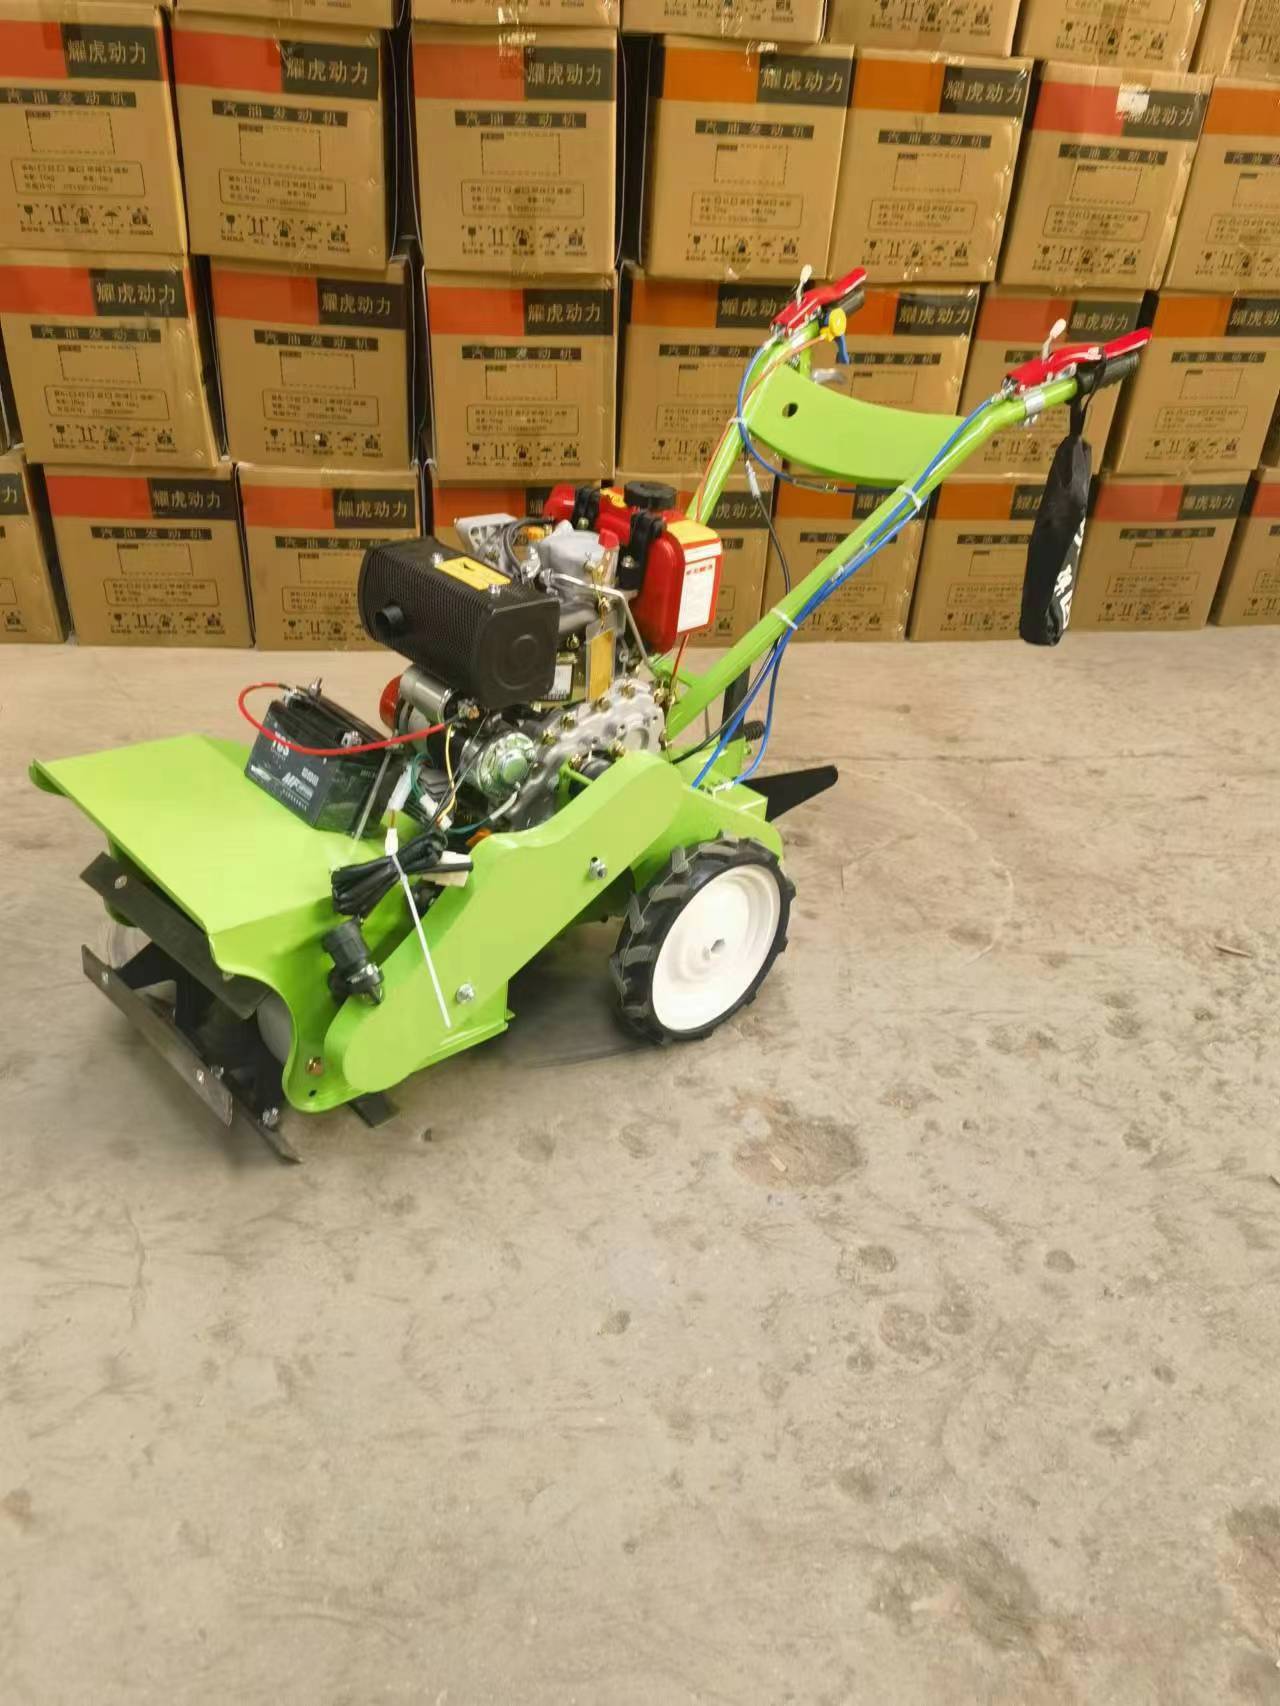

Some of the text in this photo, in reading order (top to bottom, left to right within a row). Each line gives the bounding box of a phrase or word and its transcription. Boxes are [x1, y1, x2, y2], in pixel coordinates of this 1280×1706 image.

[69, 40, 146, 64] 耀虎动力
[287, 58, 368, 84] 耀虎动力
[528, 63, 602, 87] 耀虎动力
[761, 66, 843, 93] 耀虎动力
[945, 81, 1022, 105] 耀虎动力
[97, 283, 175, 305] 耀虎动力
[321, 292, 391, 315] 耀虎动力
[528, 303, 601, 323] 耀虎动力
[721, 298, 777, 318] 耀虎动
[899, 305, 970, 325] 耀虎动力
[153, 490, 221, 509] 耀虎动力
[338, 500, 407, 519] 耀虎动力
